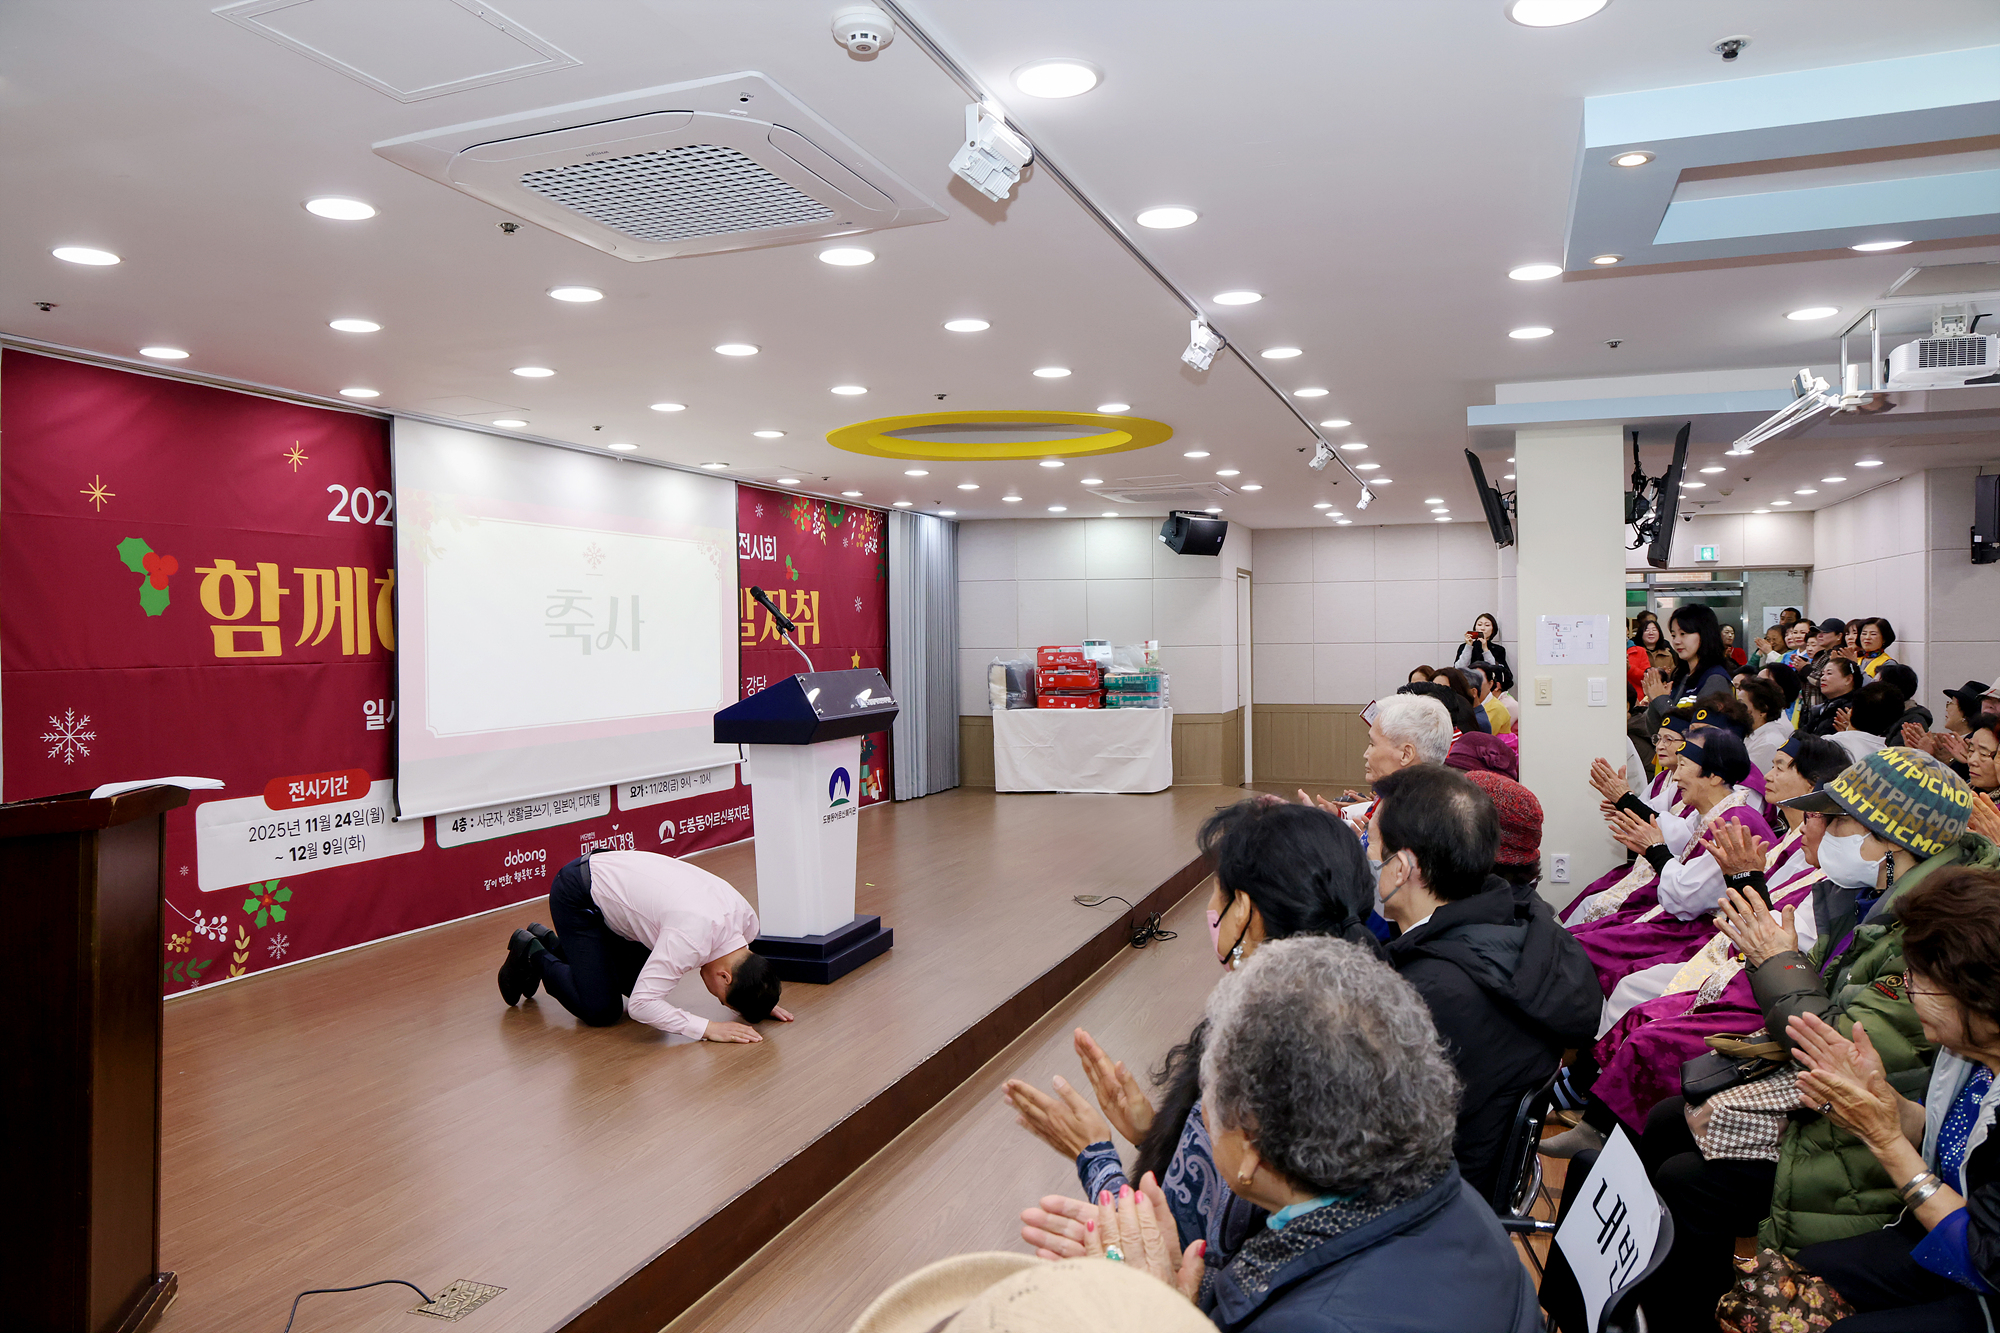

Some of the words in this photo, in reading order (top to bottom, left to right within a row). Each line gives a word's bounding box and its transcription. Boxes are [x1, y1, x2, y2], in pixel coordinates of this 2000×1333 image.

[738, 532, 777, 562] 전시회
[545, 589, 645, 655] 축사
[363, 699, 395, 731] 일
[288, 775, 349, 802] 전시기간
[630, 785, 644, 798] 요가
[649, 779, 679, 795] 11/28(금)
[680, 776, 692, 789] 9시
[248, 819, 301, 842] 2025년
[305, 814, 331, 833] 11월
[334, 807, 385, 828] 24일(월)
[452, 817, 467, 832] 4층
[476, 811, 505, 828] 사군자,
[506, 802, 552, 823] 생활글쓰기,
[553, 797, 578, 815] 일본어,
[578, 793, 600, 809] 디지털
[678, 804, 751, 835] 도봉동어르신복지관
[289, 842, 318, 861] 12월
[322, 834, 366, 855] 9일(화)
[504, 849, 547, 867] dobong
[534, 864, 547, 878] 도봉
[1592, 1177, 1639, 1296] 내빈
